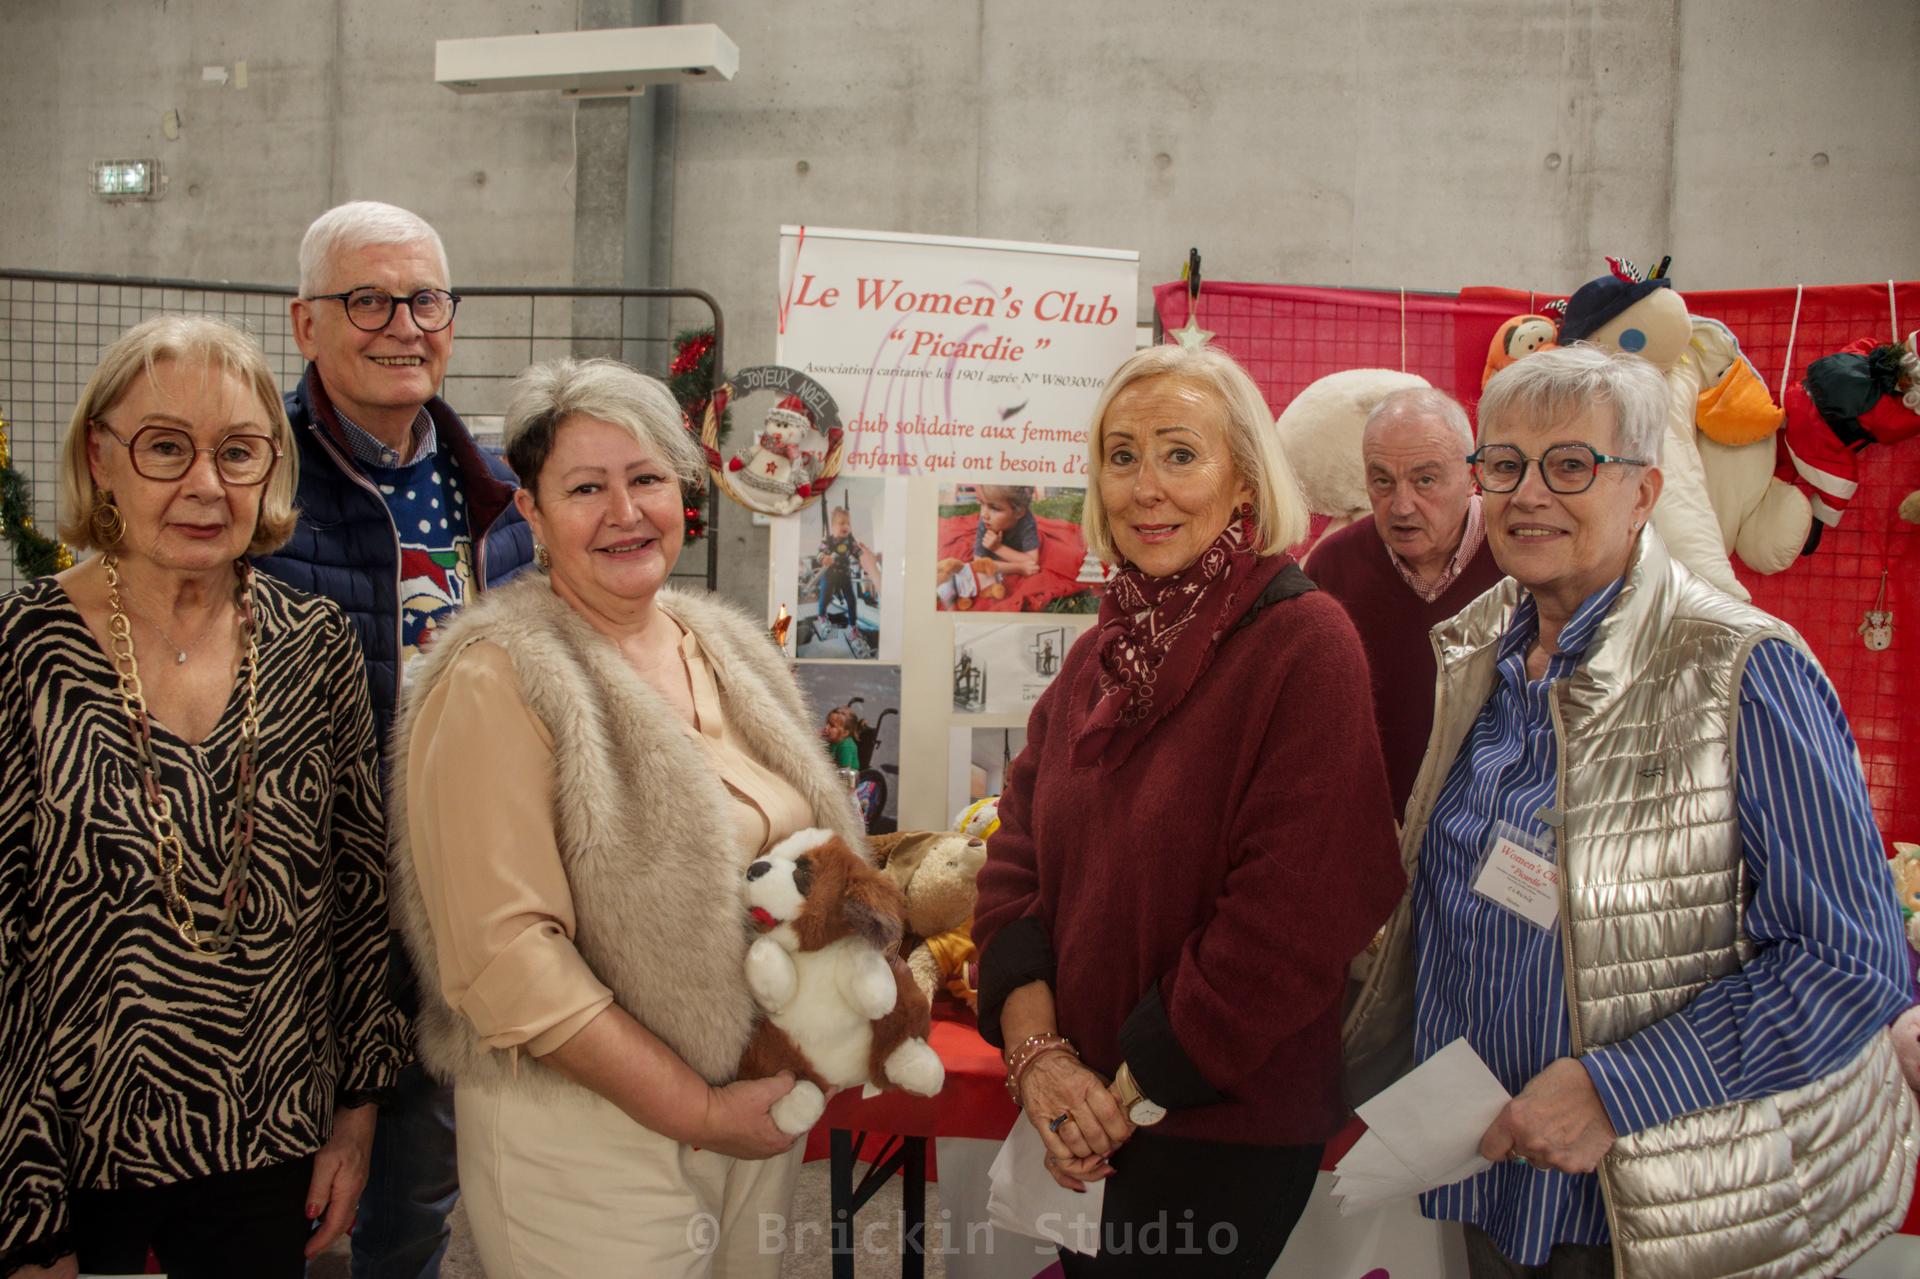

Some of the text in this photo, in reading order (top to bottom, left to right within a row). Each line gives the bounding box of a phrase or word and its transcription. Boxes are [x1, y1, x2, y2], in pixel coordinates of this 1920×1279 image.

[793, 274, 1118, 326] Le Women's Club
[742, 369, 795, 390] JOYEUX
[804, 361, 873, 376] Association
[876, 366, 933, 379] caritative
[956, 369, 984, 383] 1901
[848, 411, 1089, 444] club solidaire aux femmes
[847, 446, 918, 470] enfants
[924, 451, 956, 472] qui
[962, 456, 993, 471] ont
[1000, 451, 1056, 473] besoin
[1501, 845, 1543, 875] Women's
